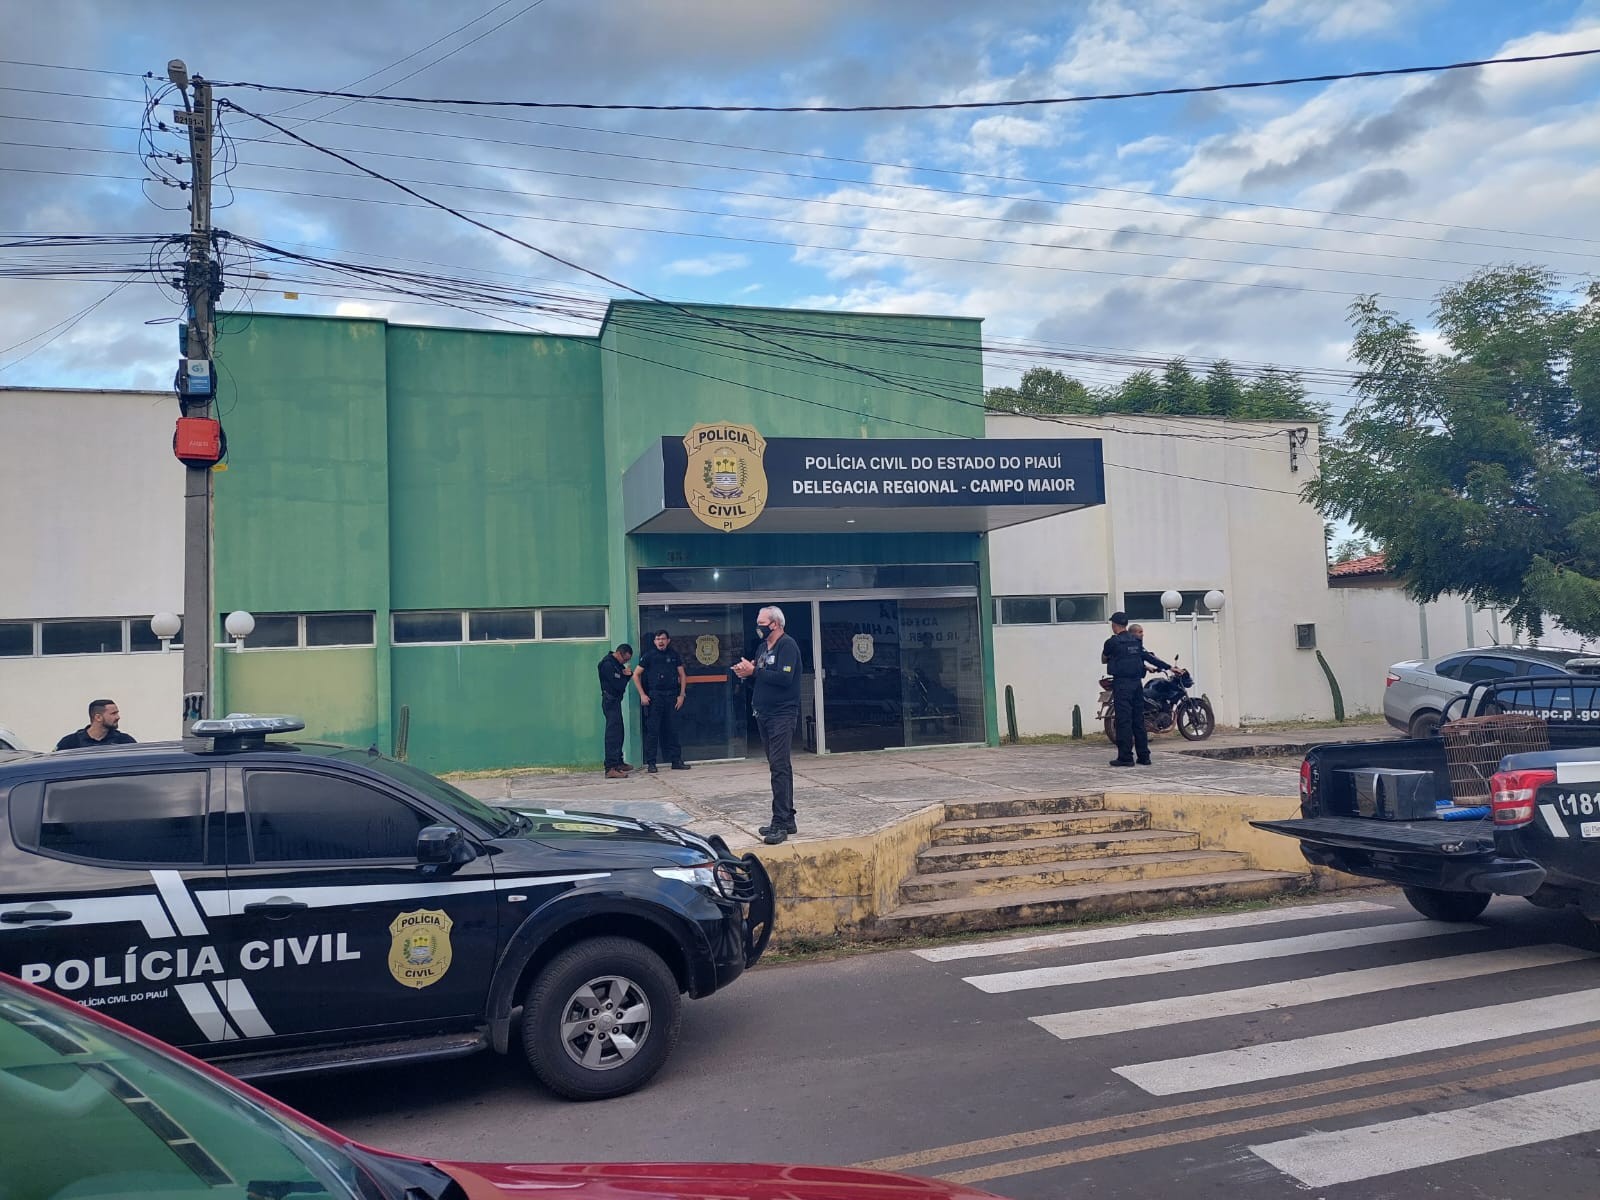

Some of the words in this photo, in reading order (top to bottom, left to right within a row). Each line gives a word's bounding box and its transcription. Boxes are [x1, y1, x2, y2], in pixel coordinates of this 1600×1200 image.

[699, 427, 750, 444] POLÍCIA
[805, 453, 867, 470] POLÍCIA
[870, 457, 907, 470] CIVIL
[911, 457, 933, 470] DO
[937, 457, 995, 470] ESTADO
[1000, 456, 1020, 469] DO
[1024, 452, 1061, 469] PIAUÍ
[792, 480, 879, 494] DELEGACIA
[883, 479, 958, 494] REGIONAL
[970, 479, 1024, 493] CAMPO
[1027, 478, 1075, 492] MAIOR
[708, 504, 746, 516] CIVIL
[723, 521, 733, 529] PI
[401, 912, 441, 928] POLÍCIA
[21, 945, 225, 991] POLÍCIA
[240, 932, 361, 971] CIVIL
[405, 969, 434, 978] CIVIL
[76, 997, 106, 1007] OLÍCIA
[107, 996, 129, 1004] CIVIL
[131, 993, 144, 1002] DO
[145, 988, 168, 1000] PIAUÍ
